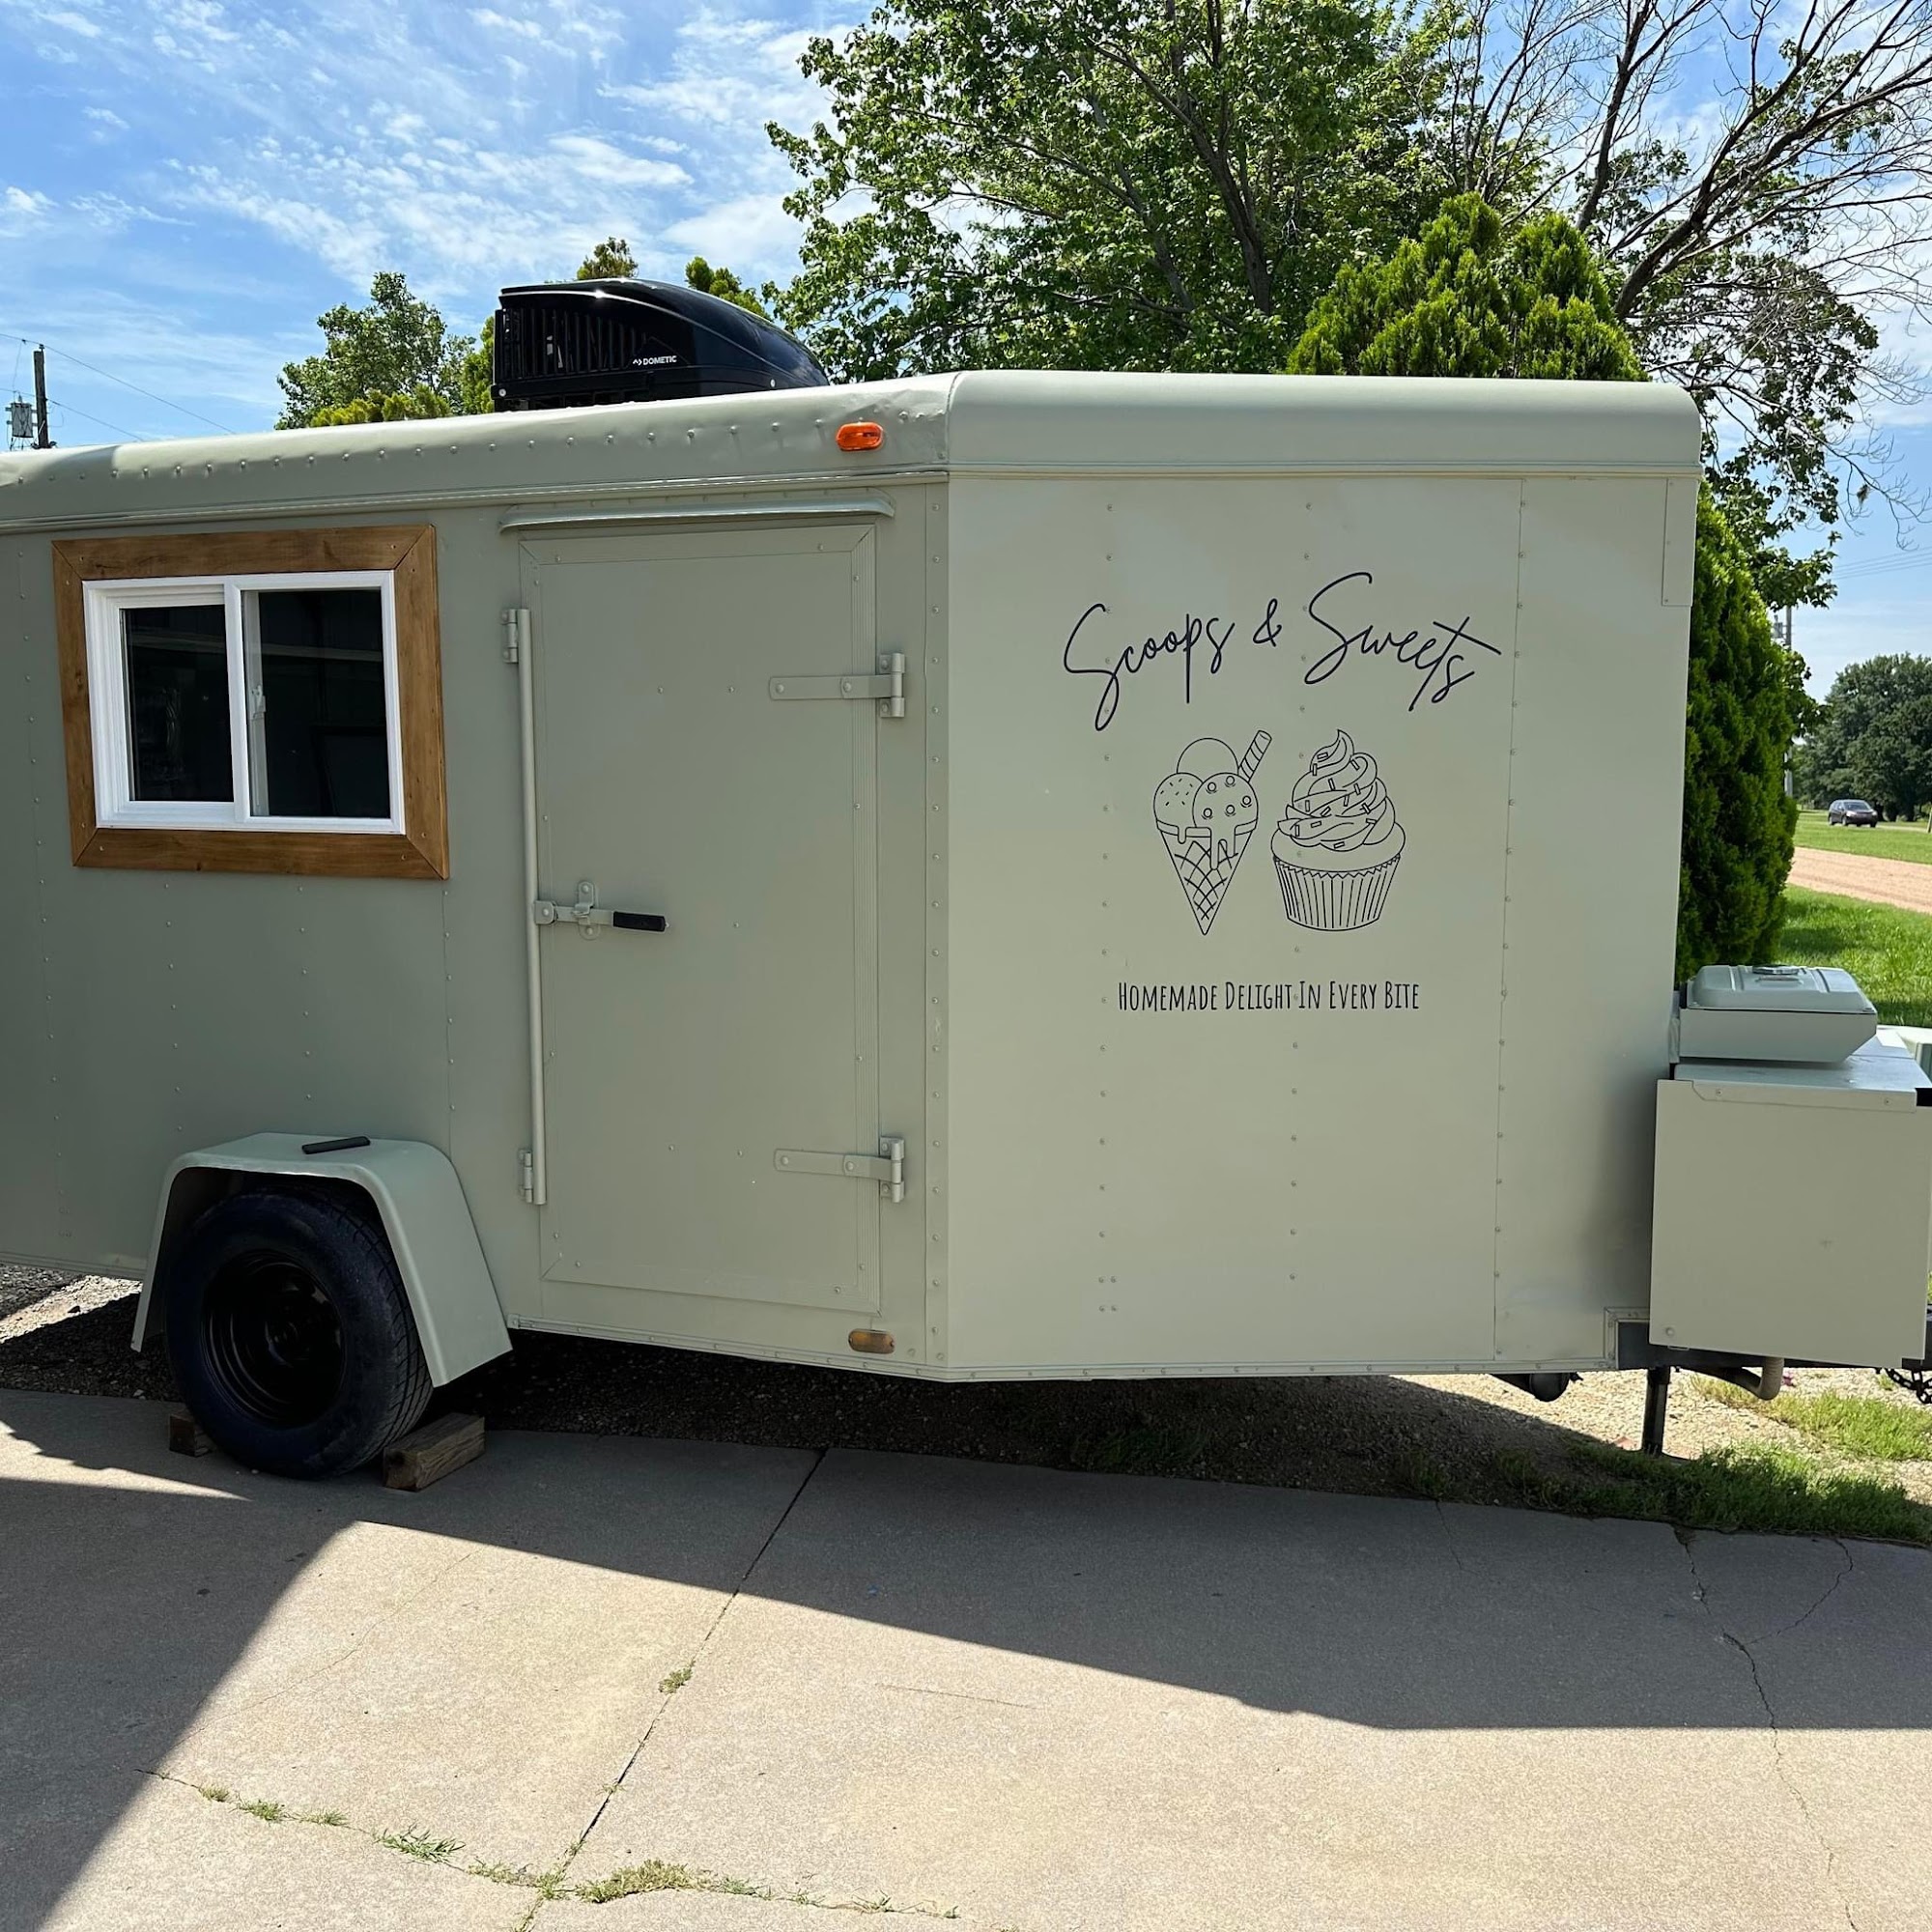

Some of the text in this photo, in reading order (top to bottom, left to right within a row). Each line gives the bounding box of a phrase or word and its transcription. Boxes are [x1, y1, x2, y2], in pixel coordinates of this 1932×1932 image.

[642, 355, 677, 366] DOMETIC
[1064, 571, 1502, 731] Scoops & Sweets
